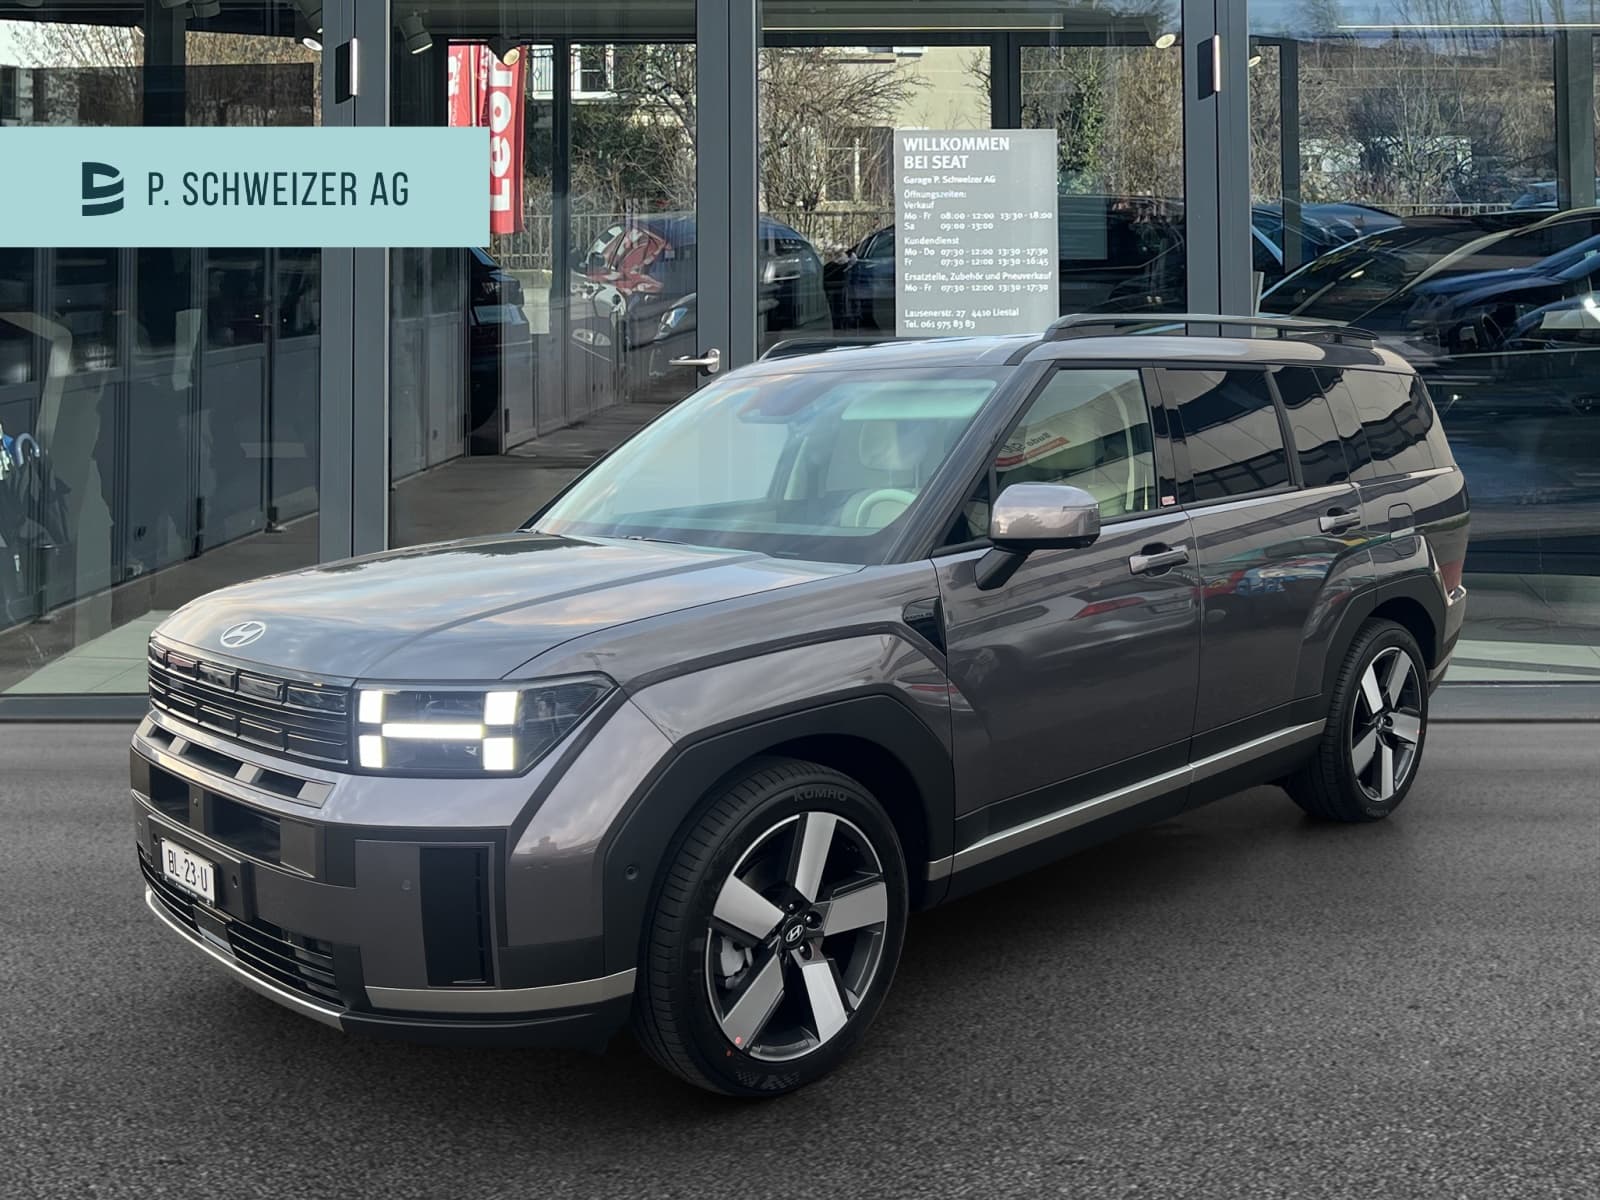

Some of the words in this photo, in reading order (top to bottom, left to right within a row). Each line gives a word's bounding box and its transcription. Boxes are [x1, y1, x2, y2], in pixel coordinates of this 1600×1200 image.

[903, 137, 1010, 151] WILLKOMMEN
[904, 155, 928, 169] BEI
[932, 155, 969, 169] SEAT
[903, 176, 932, 185] Garage
[934, 175, 941, 183] P.
[942, 175, 982, 184] Schweizer
[984, 175, 996, 183] AG
[903, 190, 967, 199] Öffnungszeiten:
[903, 201, 935, 209] Verkauf
[904, 212, 917, 220] Mo
[923, 212, 931, 220] Fr
[972, 212, 995, 220] 12:00
[1000, 211, 1023, 220] 13:30
[904, 222, 915, 231] Sa
[940, 222, 966, 231] 09:00
[972, 222, 994, 231] 13:00
[904, 236, 960, 245] Kundendienst
[904, 248, 917, 256] Mo
[923, 248, 935, 256] Do
[940, 248, 965, 258] 07:30
[971, 248, 994, 256] 12:00
[998, 248, 1021, 256] 13:30
[1026, 247, 1048, 256] 17:30
[904, 258, 913, 266] Fr
[940, 258, 965, 268] 07:30
[971, 258, 994, 266] 12:00
[998, 258, 1021, 267] 13:30
[1026, 257, 1049, 267] 16:45
[904, 272, 949, 282] Ersatzteile,
[950, 271, 984, 281] Zubehör
[985, 272, 1001, 281] und
[1002, 271, 1052, 281] Pneuverkauf
[904, 284, 917, 292] Mo
[923, 284, 932, 292] Fr
[940, 284, 965, 294] 07:30
[971, 284, 994, 292] 12:00
[998, 284, 1021, 293] 13:30
[1026, 283, 1049, 292] 17:30
[904, 309, 954, 318] Lausenerstr.
[956, 309, 967, 318] 27
[971, 309, 992, 318] 4410
[992, 308, 1019, 317] Liestal
[904, 319, 919, 328] Tel.
[920, 319, 936, 328] 061
[936, 320, 952, 330] 975
[952, 319, 964, 329] 83
[965, 319, 976, 329] 83
[793, 787, 847, 802] KUMHO
